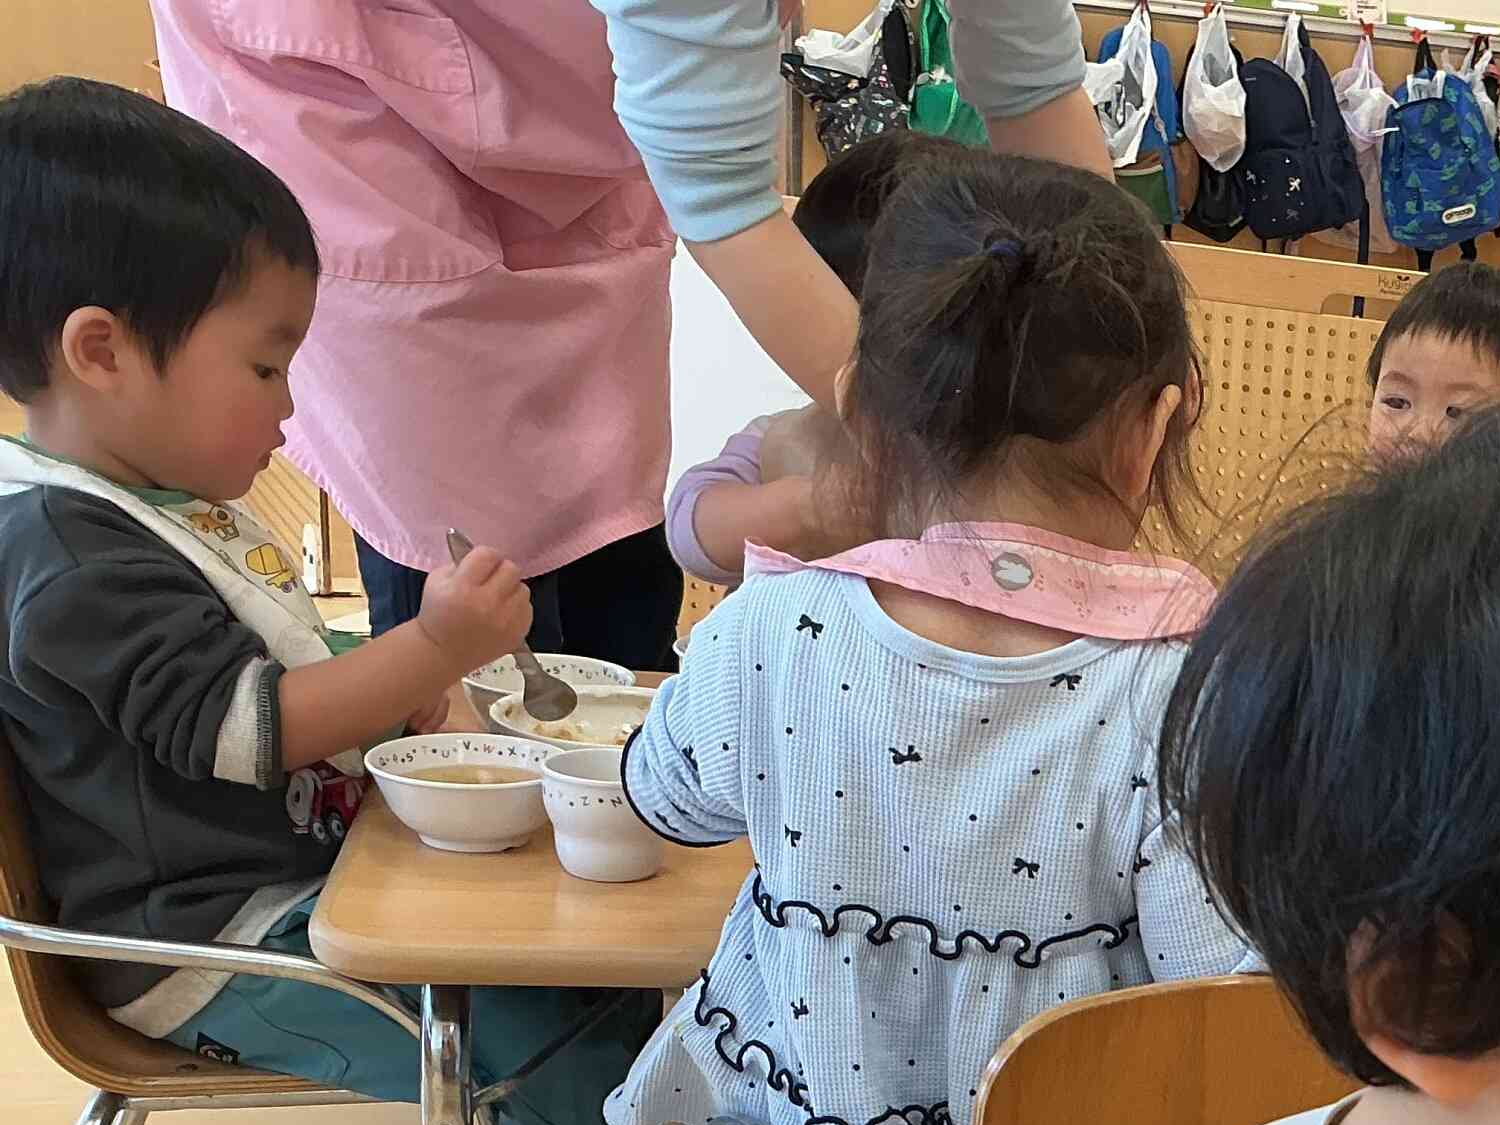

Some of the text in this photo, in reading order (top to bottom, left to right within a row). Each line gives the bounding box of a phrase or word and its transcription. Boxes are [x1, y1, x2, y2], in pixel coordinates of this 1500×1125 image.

[405, 752, 414, 763] S
[441, 749, 450, 759] U
[463, 740, 471, 751] V
[507, 745, 517, 757] X
